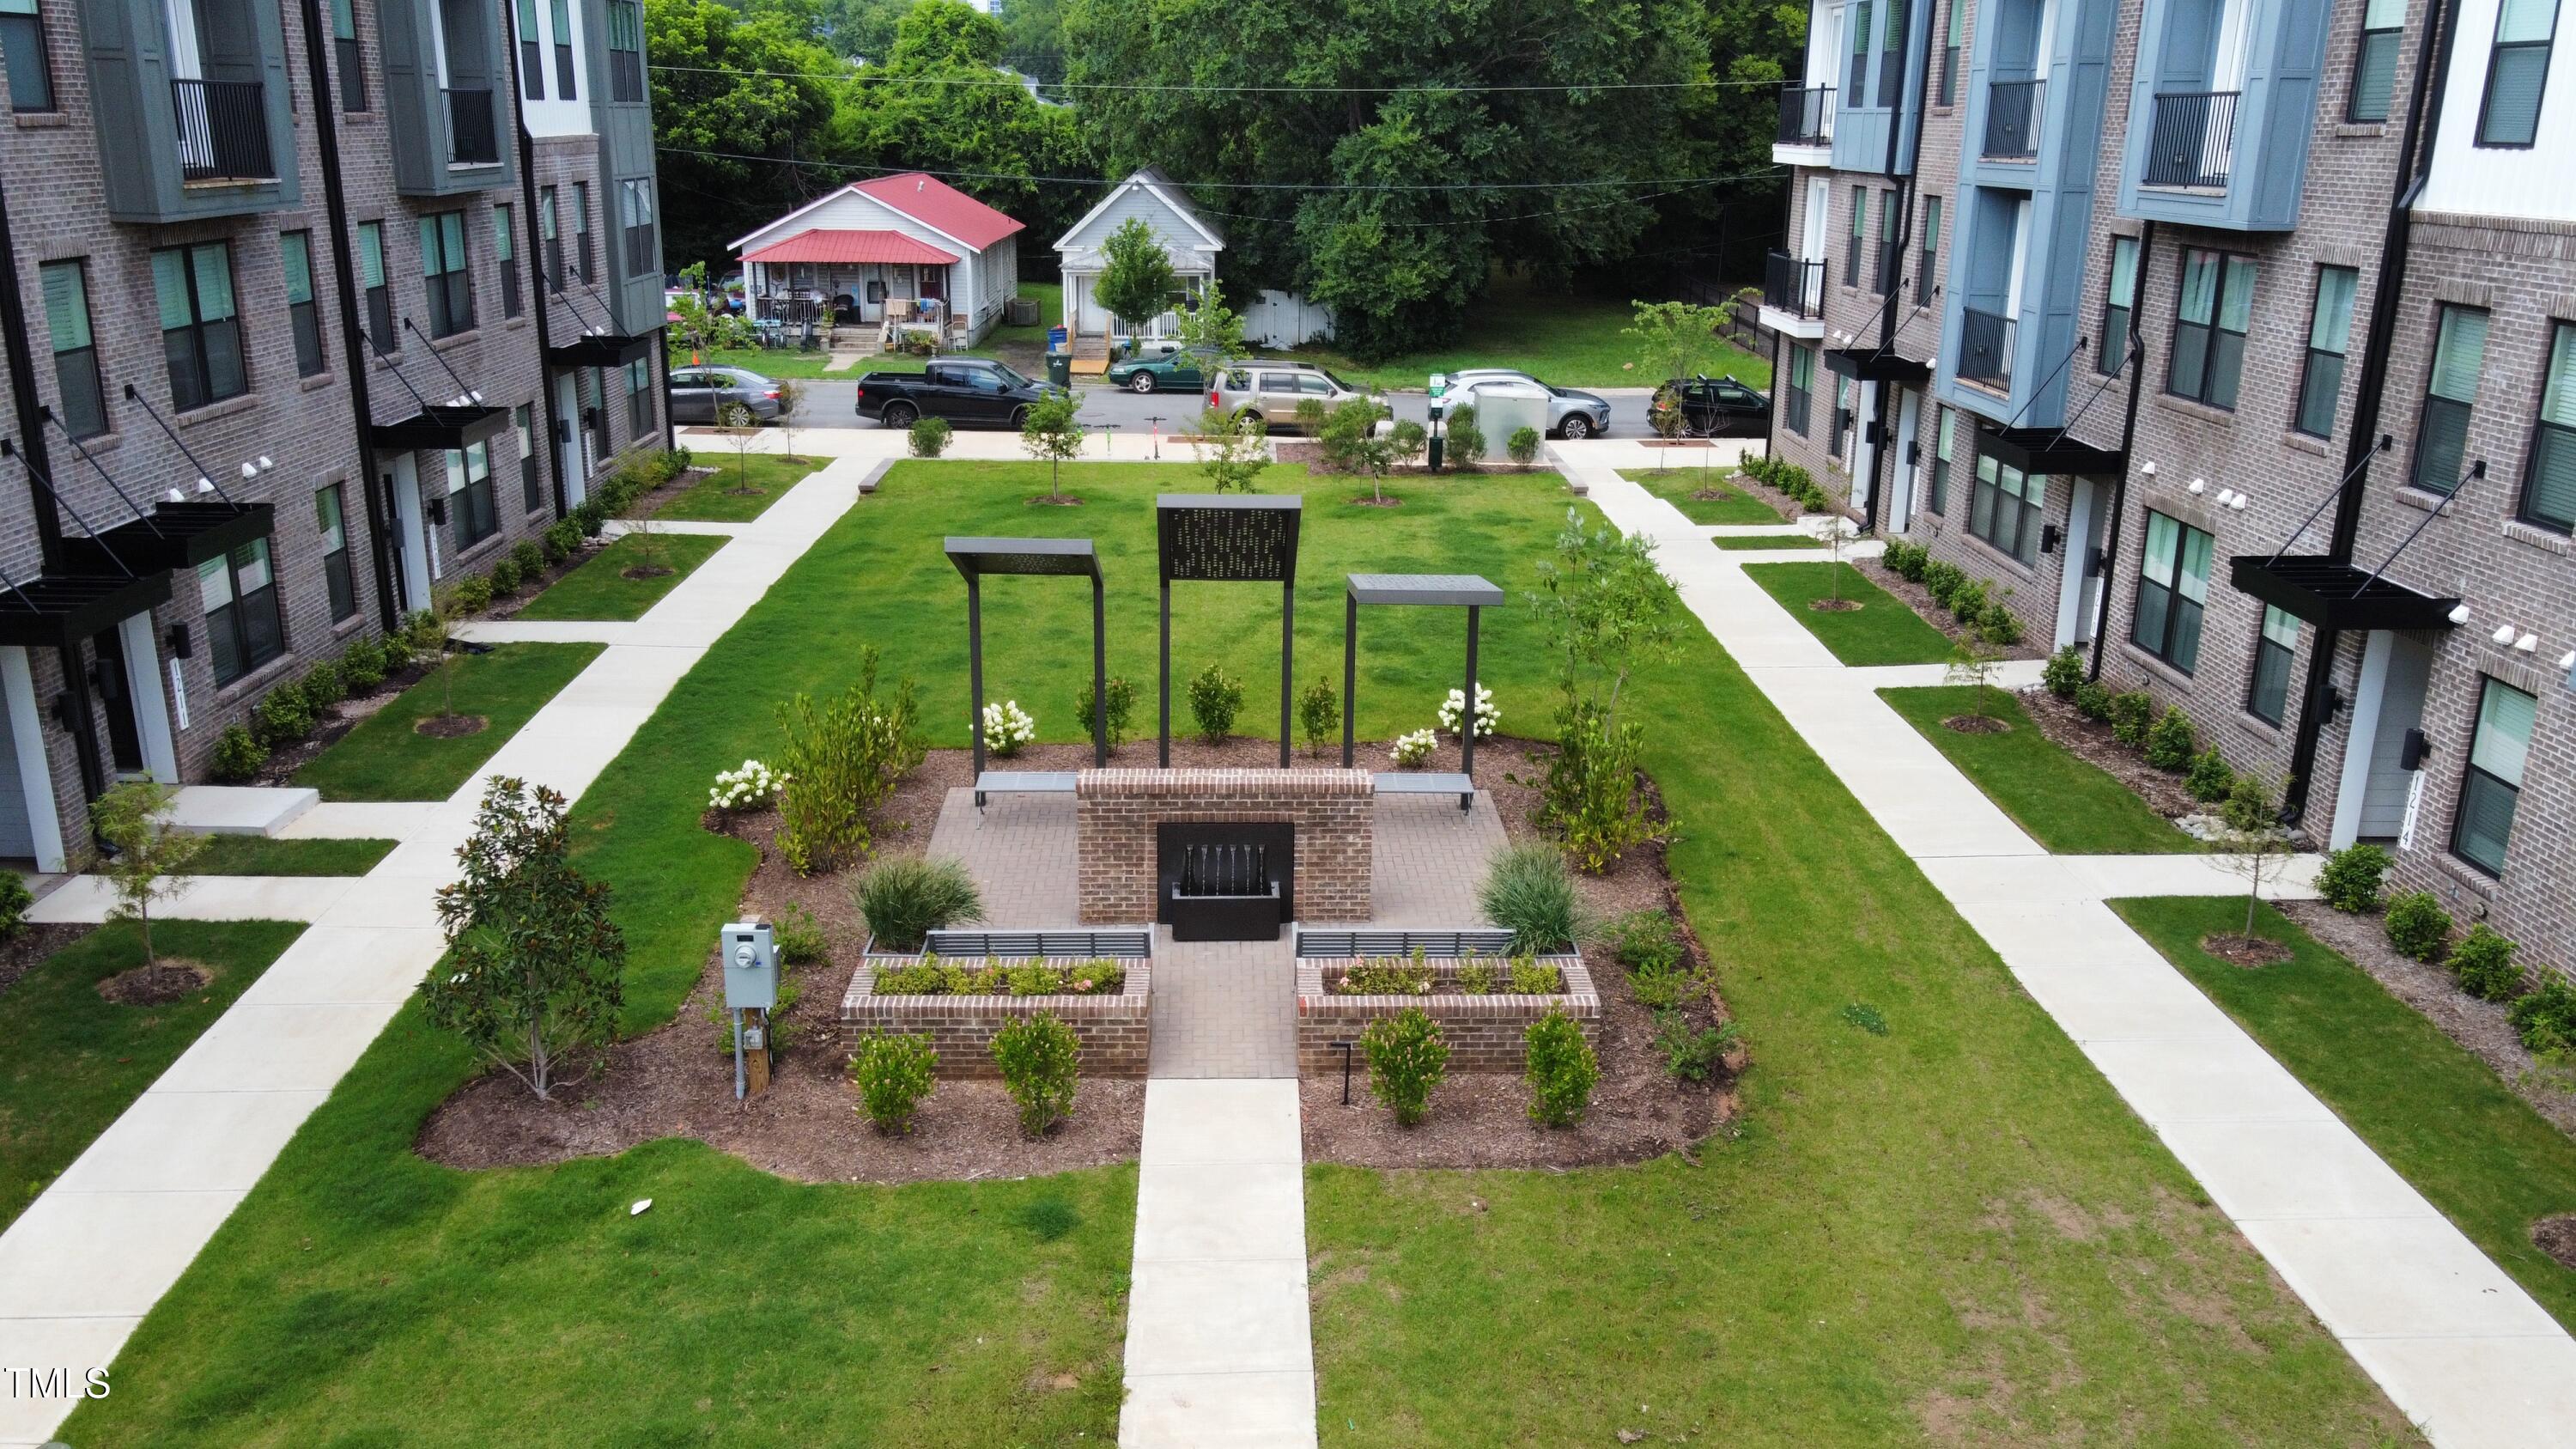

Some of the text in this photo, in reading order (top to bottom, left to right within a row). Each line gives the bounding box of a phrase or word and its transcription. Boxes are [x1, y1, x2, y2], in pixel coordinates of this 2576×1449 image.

[2091, 581, 2101, 633] 1210
[174, 662, 186, 725] 1211
[2402, 776, 2420, 845] 1214
